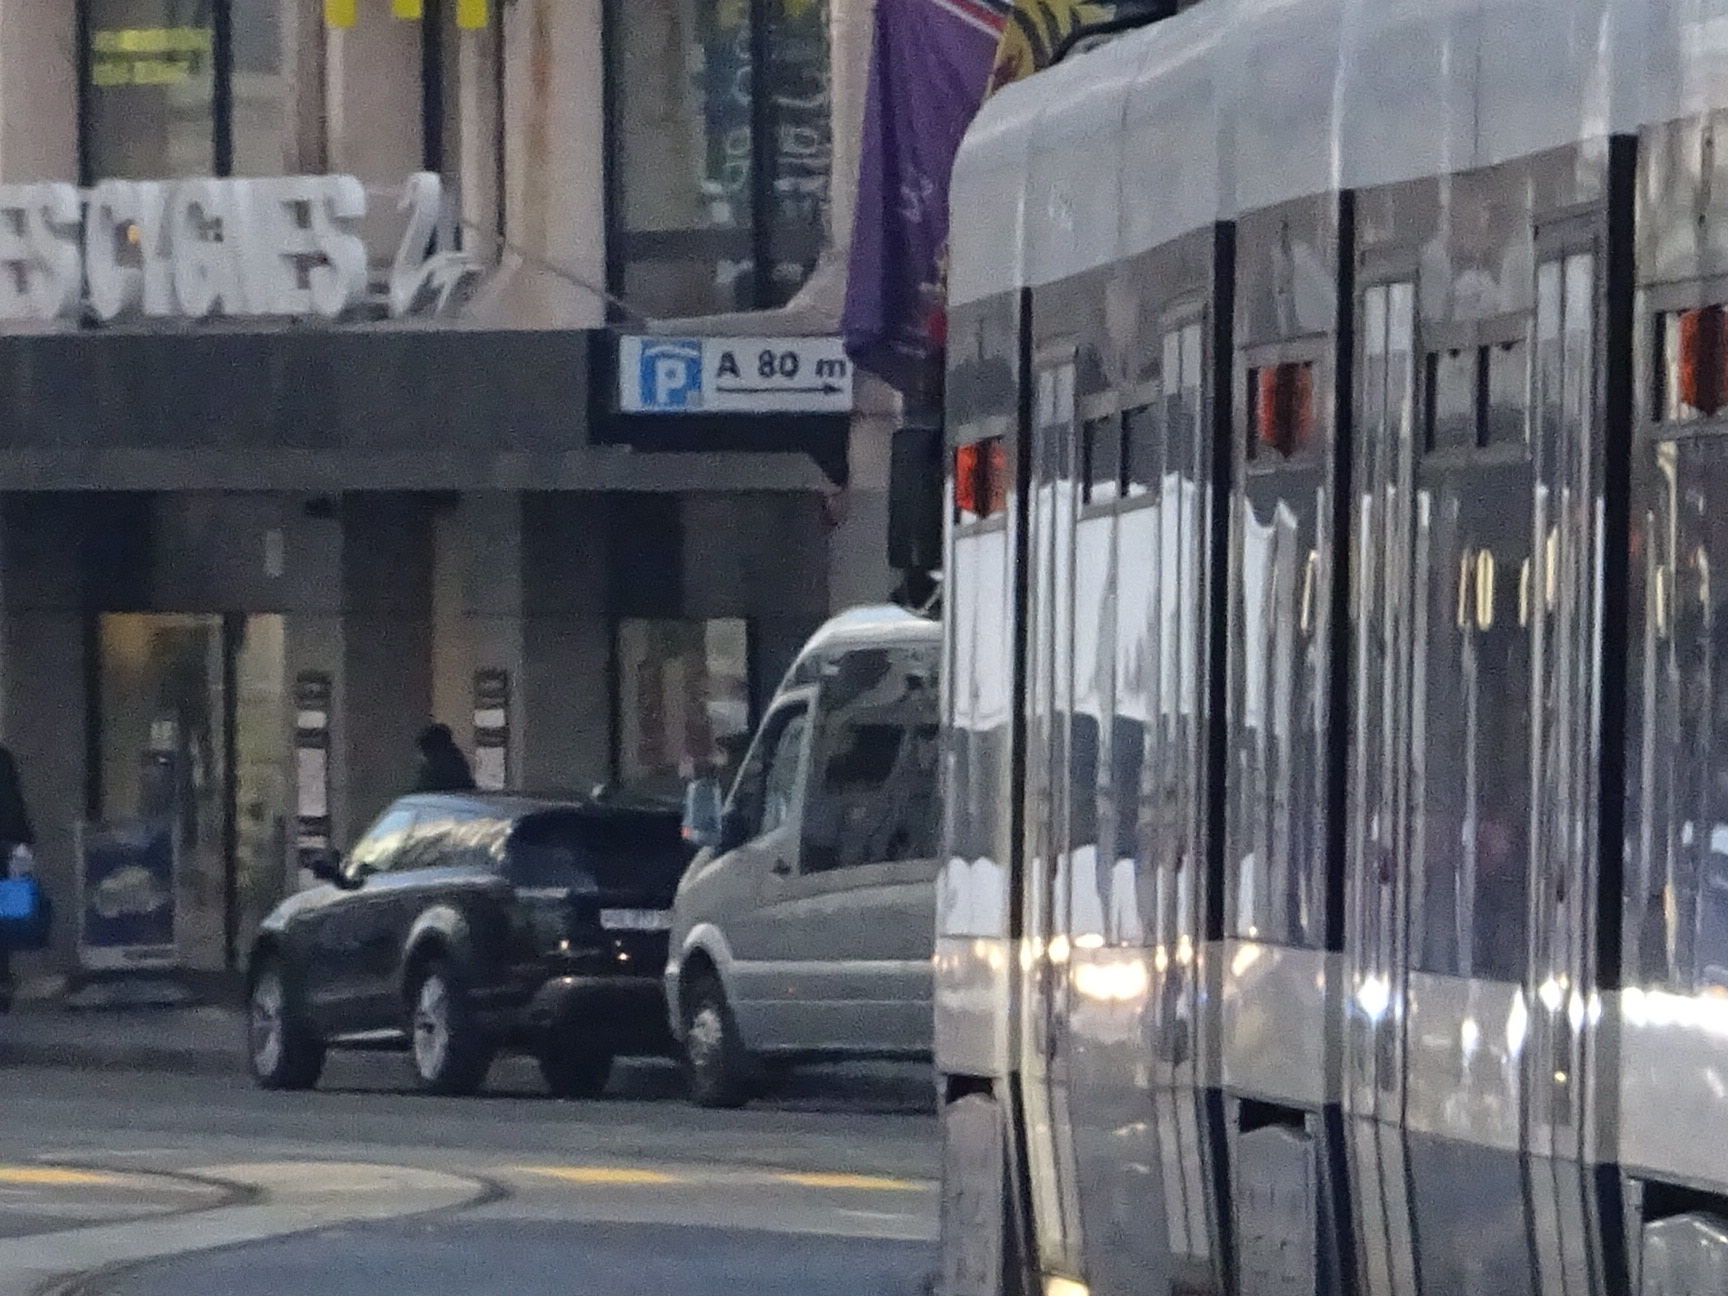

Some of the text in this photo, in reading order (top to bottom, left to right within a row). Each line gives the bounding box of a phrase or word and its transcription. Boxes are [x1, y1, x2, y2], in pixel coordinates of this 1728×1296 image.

[716, 350, 741, 378] A
[757, 349, 799, 378] 80
[815, 357, 847, 378] m
